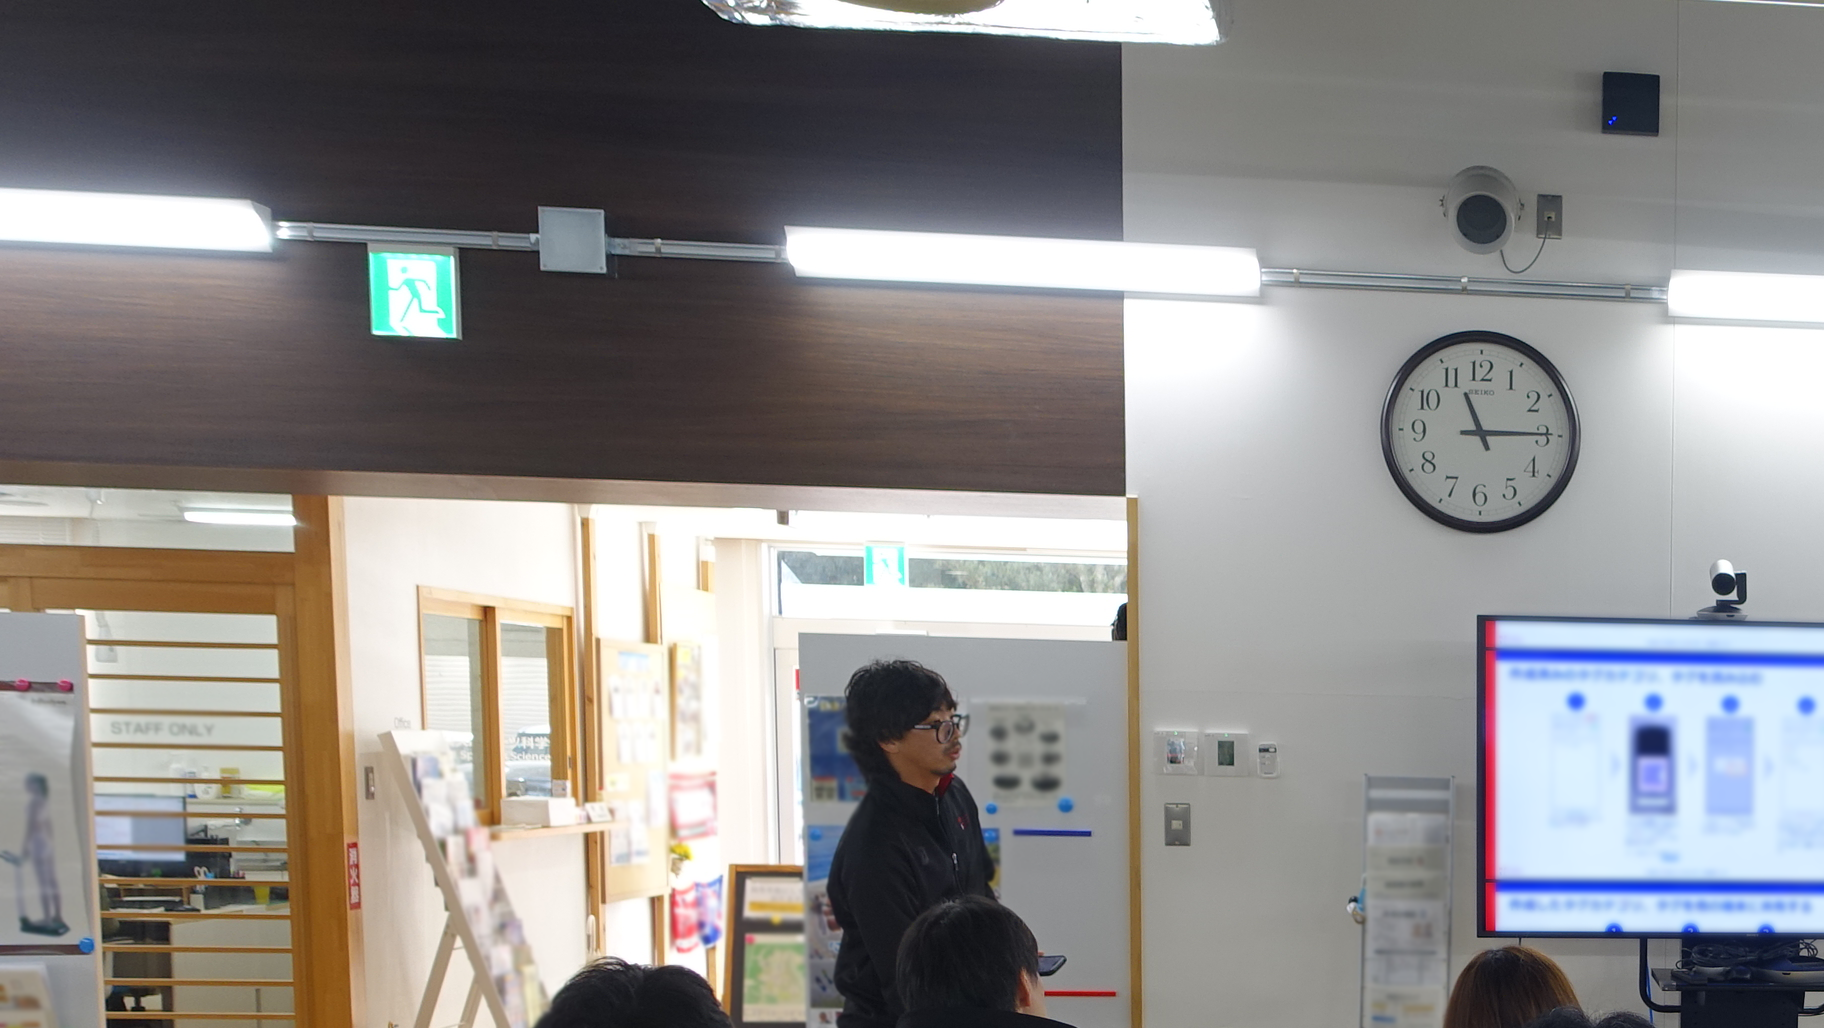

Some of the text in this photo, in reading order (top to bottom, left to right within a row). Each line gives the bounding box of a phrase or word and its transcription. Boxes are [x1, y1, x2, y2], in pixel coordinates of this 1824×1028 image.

[1442, 366, 1461, 389] 11
[1469, 360, 1494, 382] 12
[1506, 369, 1516, 391] 1
[1417, 389, 1441, 411] 10
[1526, 390, 1541, 413] 2
[1411, 419, 1427, 442] 9
[1535, 424, 1550, 447] 3
[1421, 451, 1437, 474] 8
[1523, 455, 1539, 478] 4
[1444, 475, 1459, 498] 7
[1472, 483, 1488, 507] 6
[1502, 477, 1517, 501] 5
[110, 721, 215, 737] STAFF ONLY
